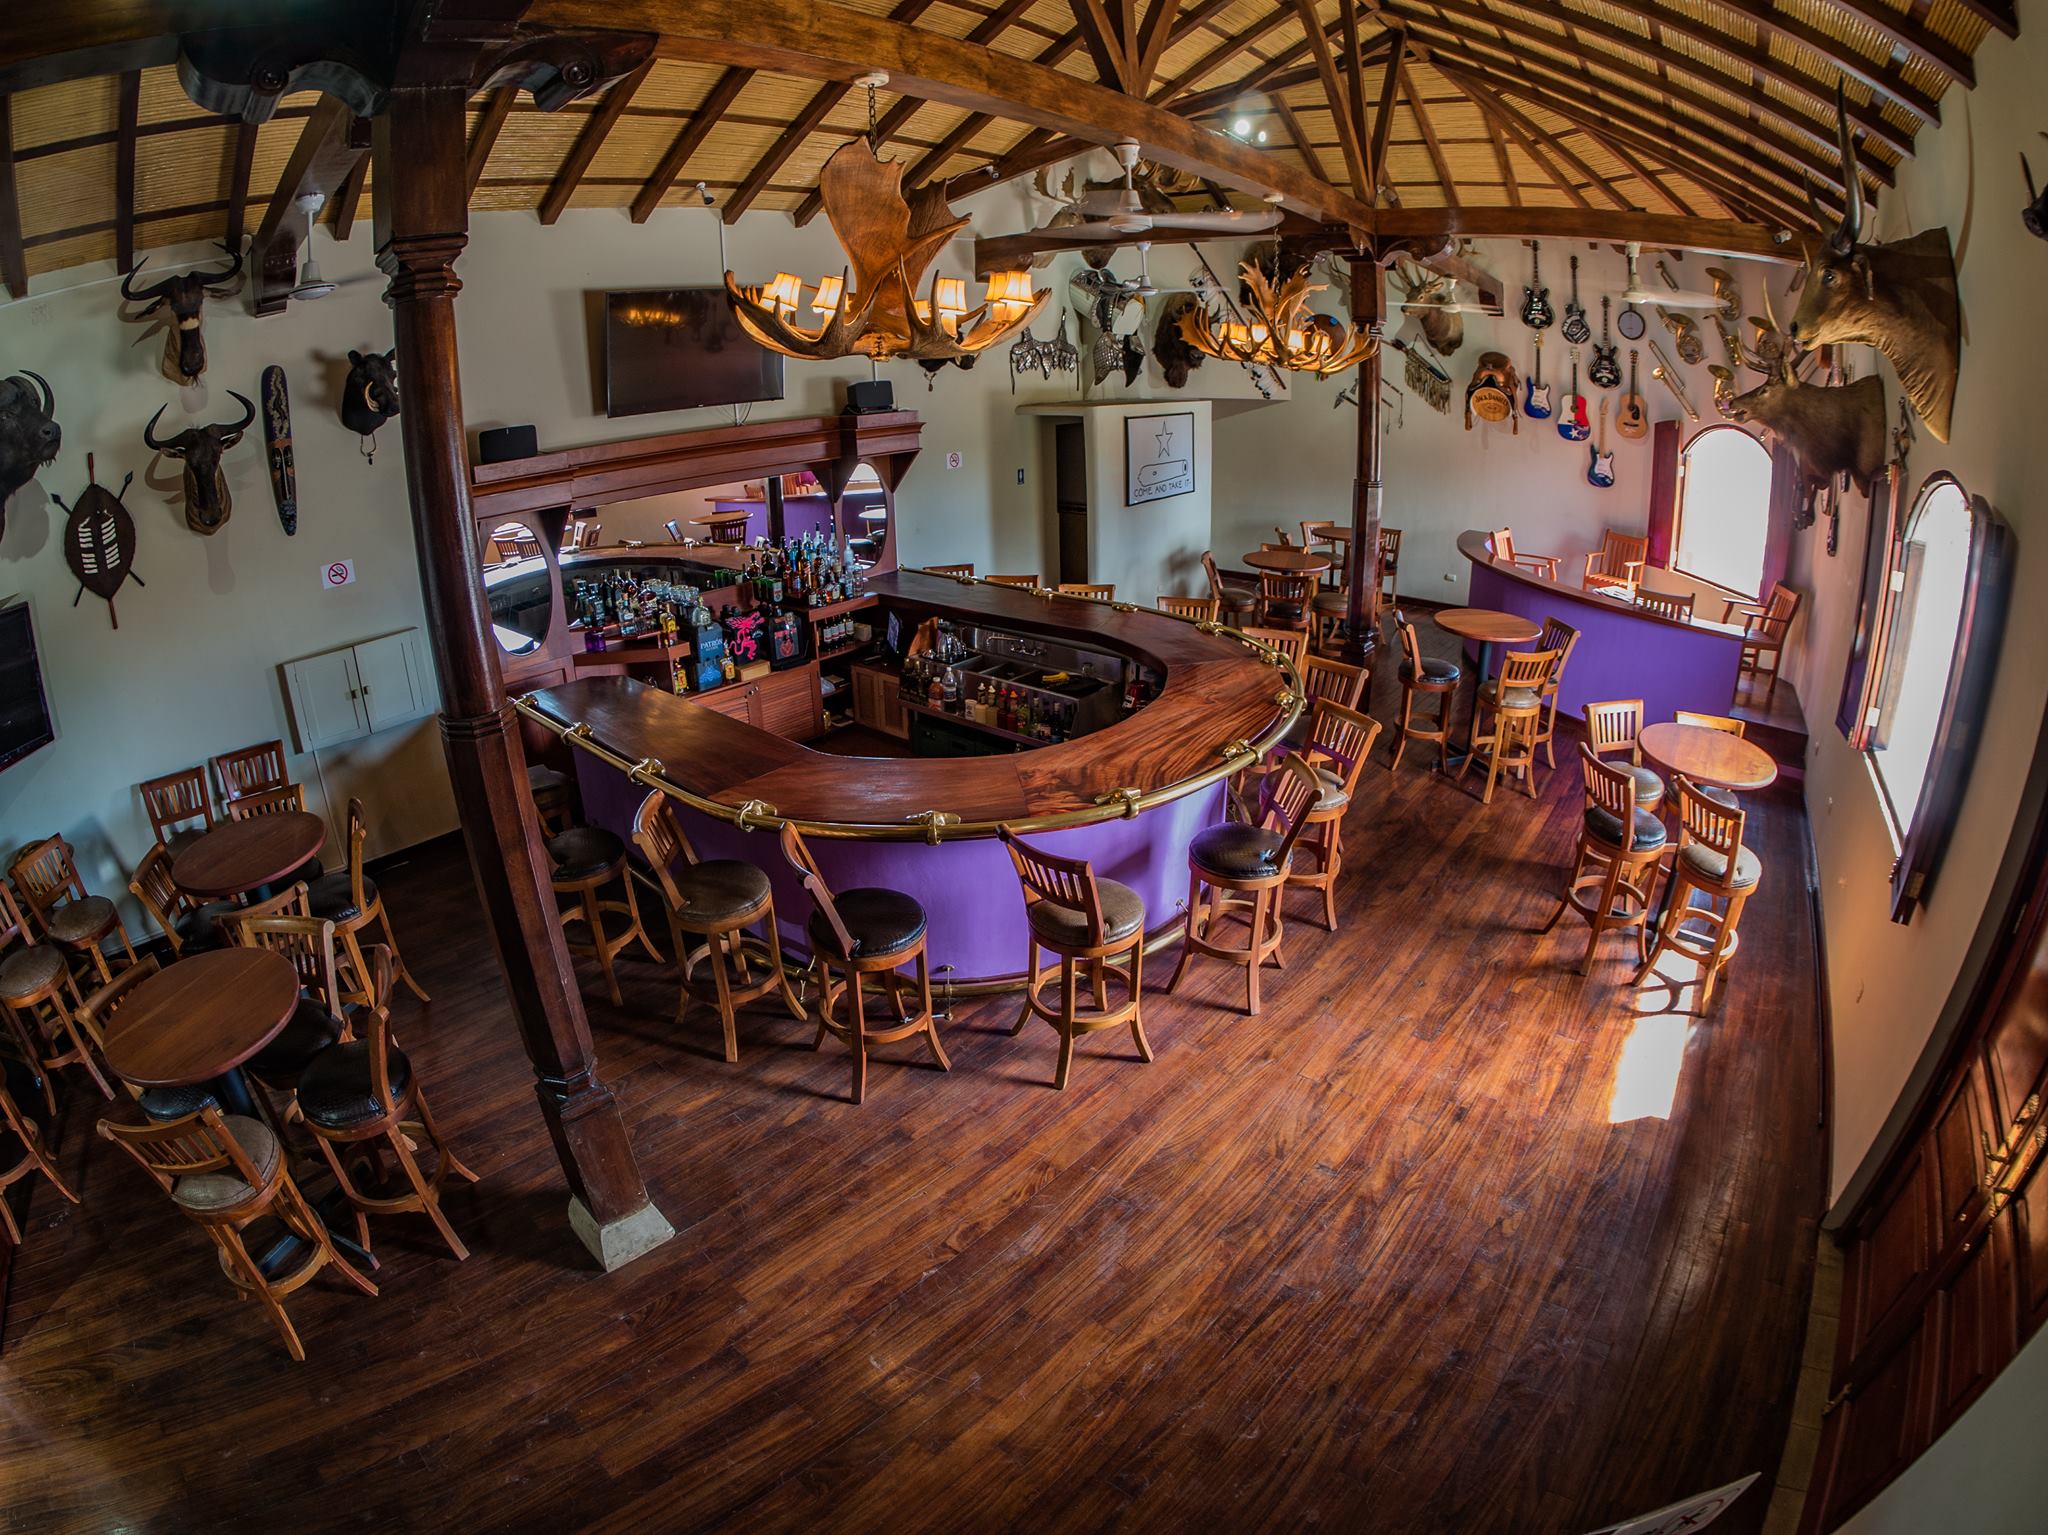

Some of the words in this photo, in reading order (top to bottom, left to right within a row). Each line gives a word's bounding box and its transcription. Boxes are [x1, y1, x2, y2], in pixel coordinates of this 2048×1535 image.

[1134, 486, 1152, 497] COME
[1155, 484, 1167, 493] AND
[1169, 480, 1183, 489] TAKE
